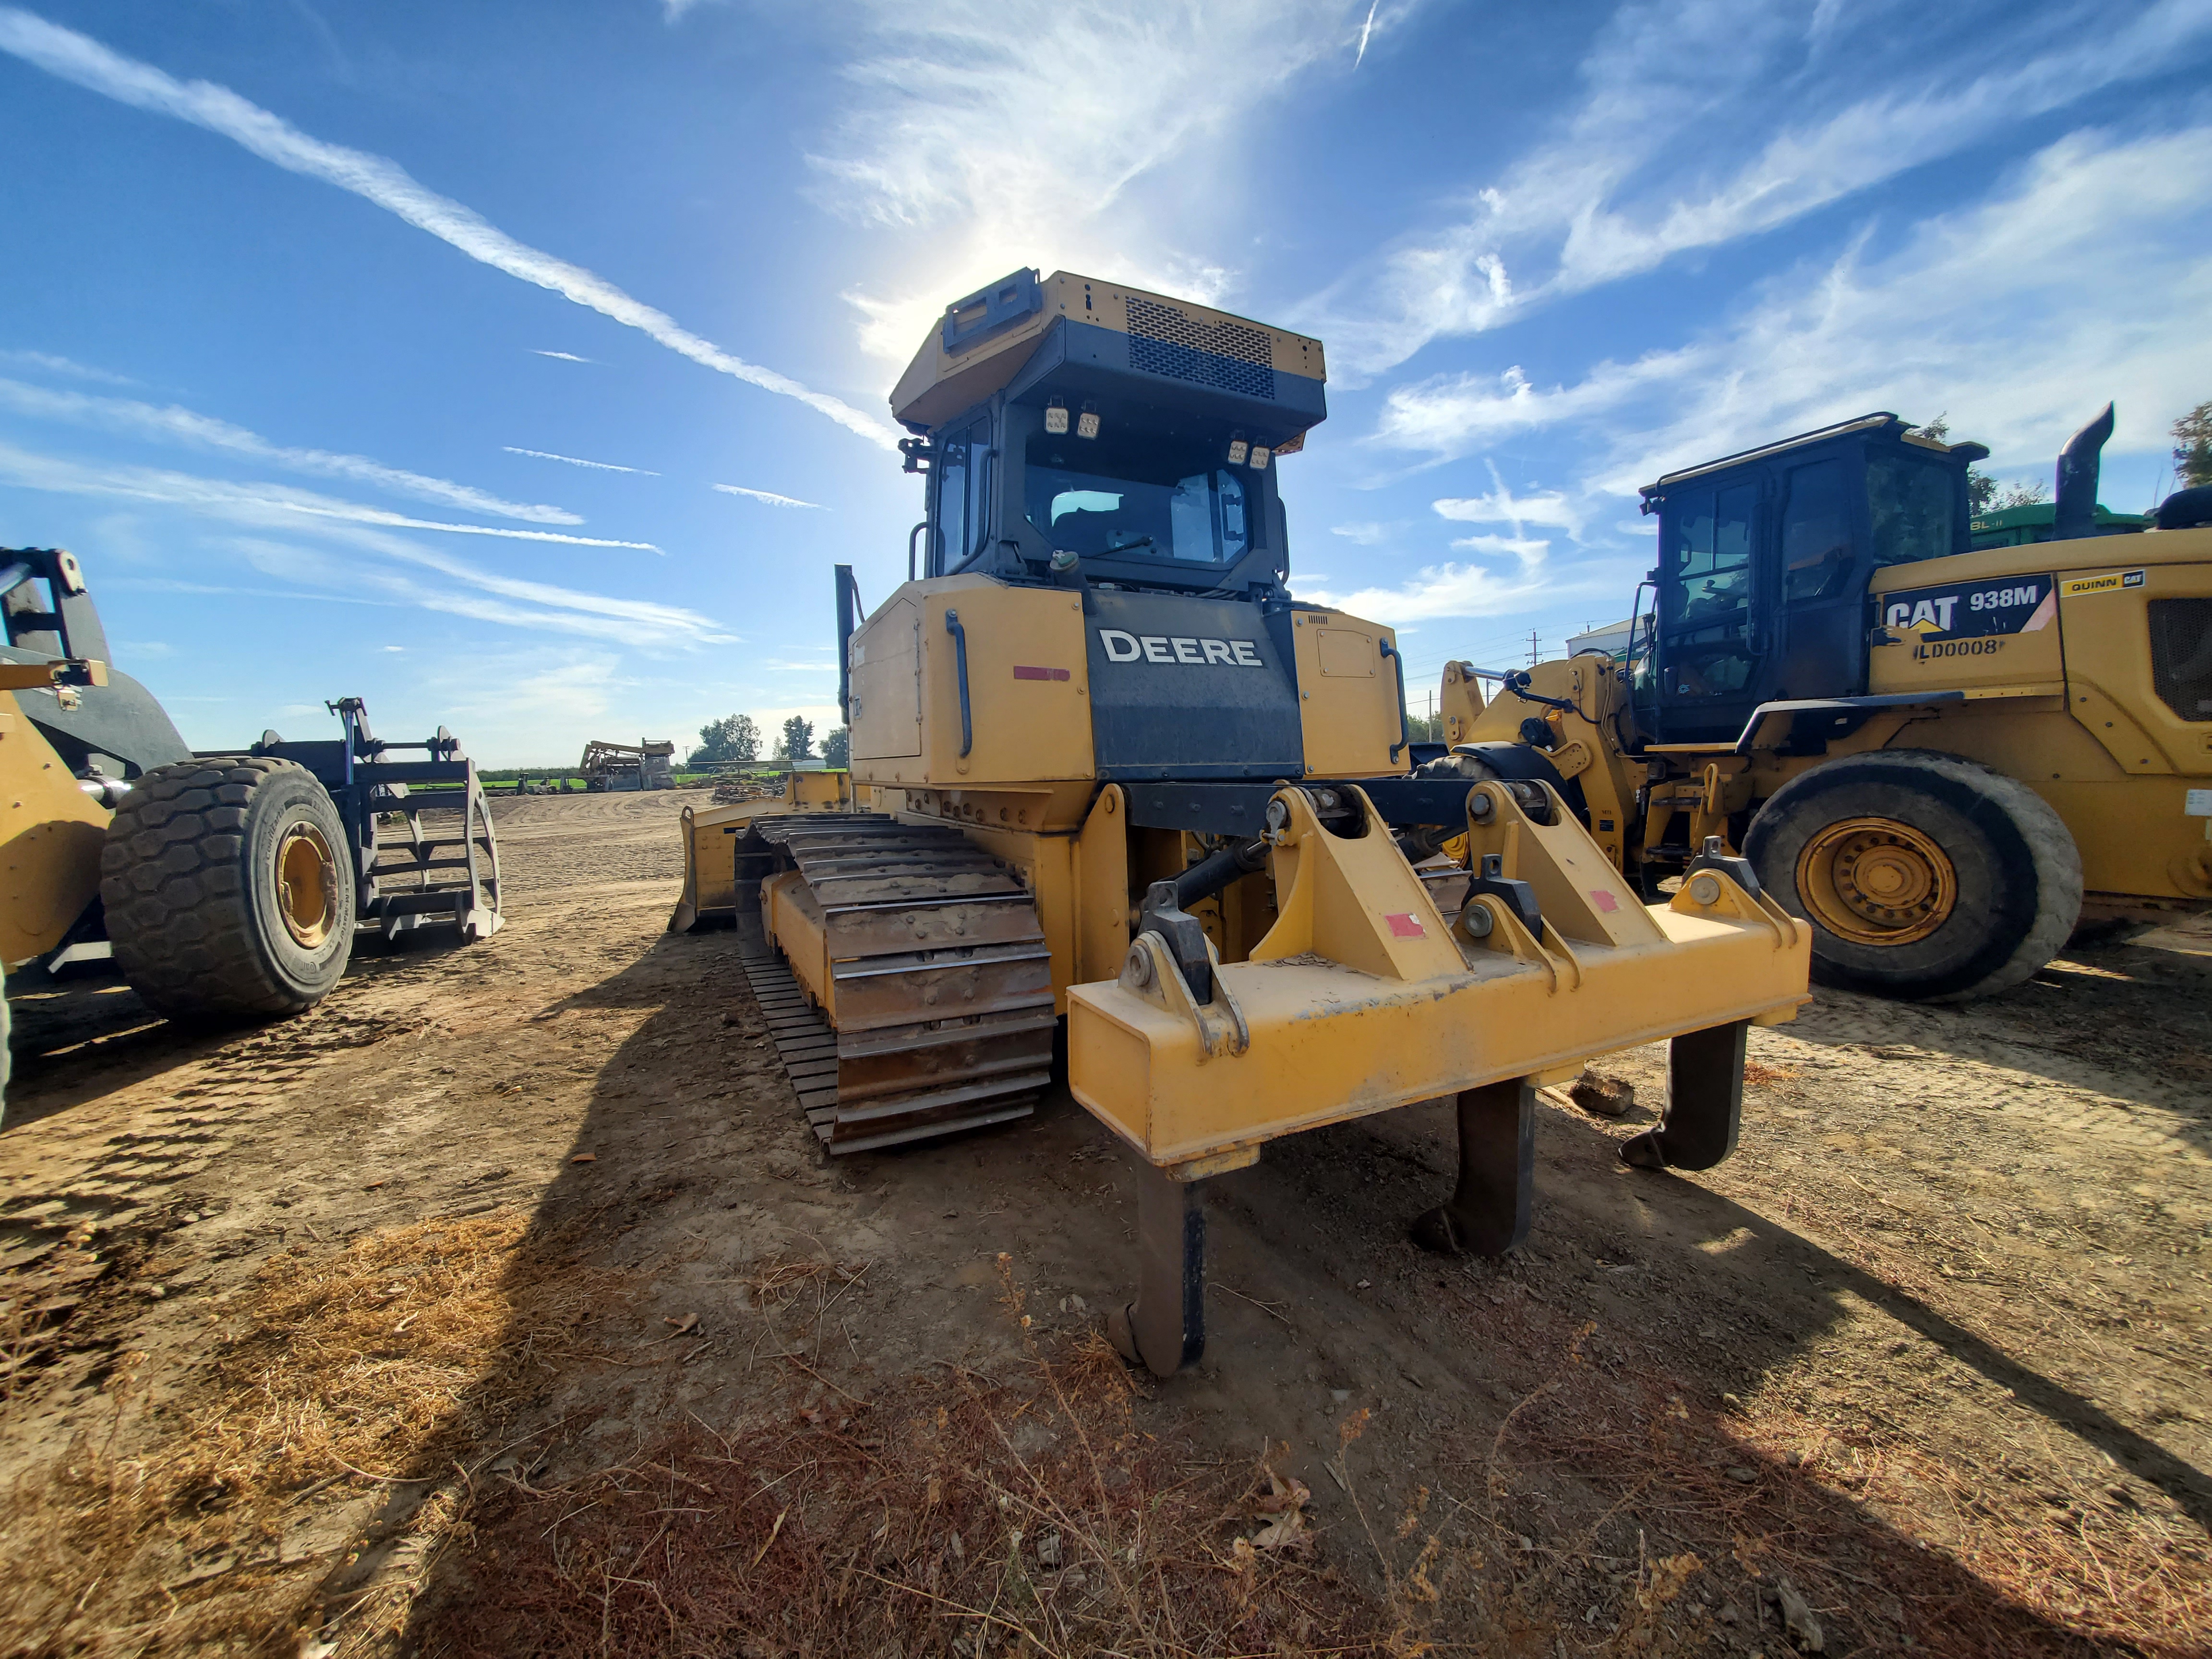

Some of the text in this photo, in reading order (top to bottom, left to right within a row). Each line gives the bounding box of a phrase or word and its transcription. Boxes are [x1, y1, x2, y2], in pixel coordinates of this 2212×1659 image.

[2072, 578, 2116, 591] QUINN
[1887, 585, 2037, 631] CAT 938M
[1099, 629, 1263, 666] DEERE
